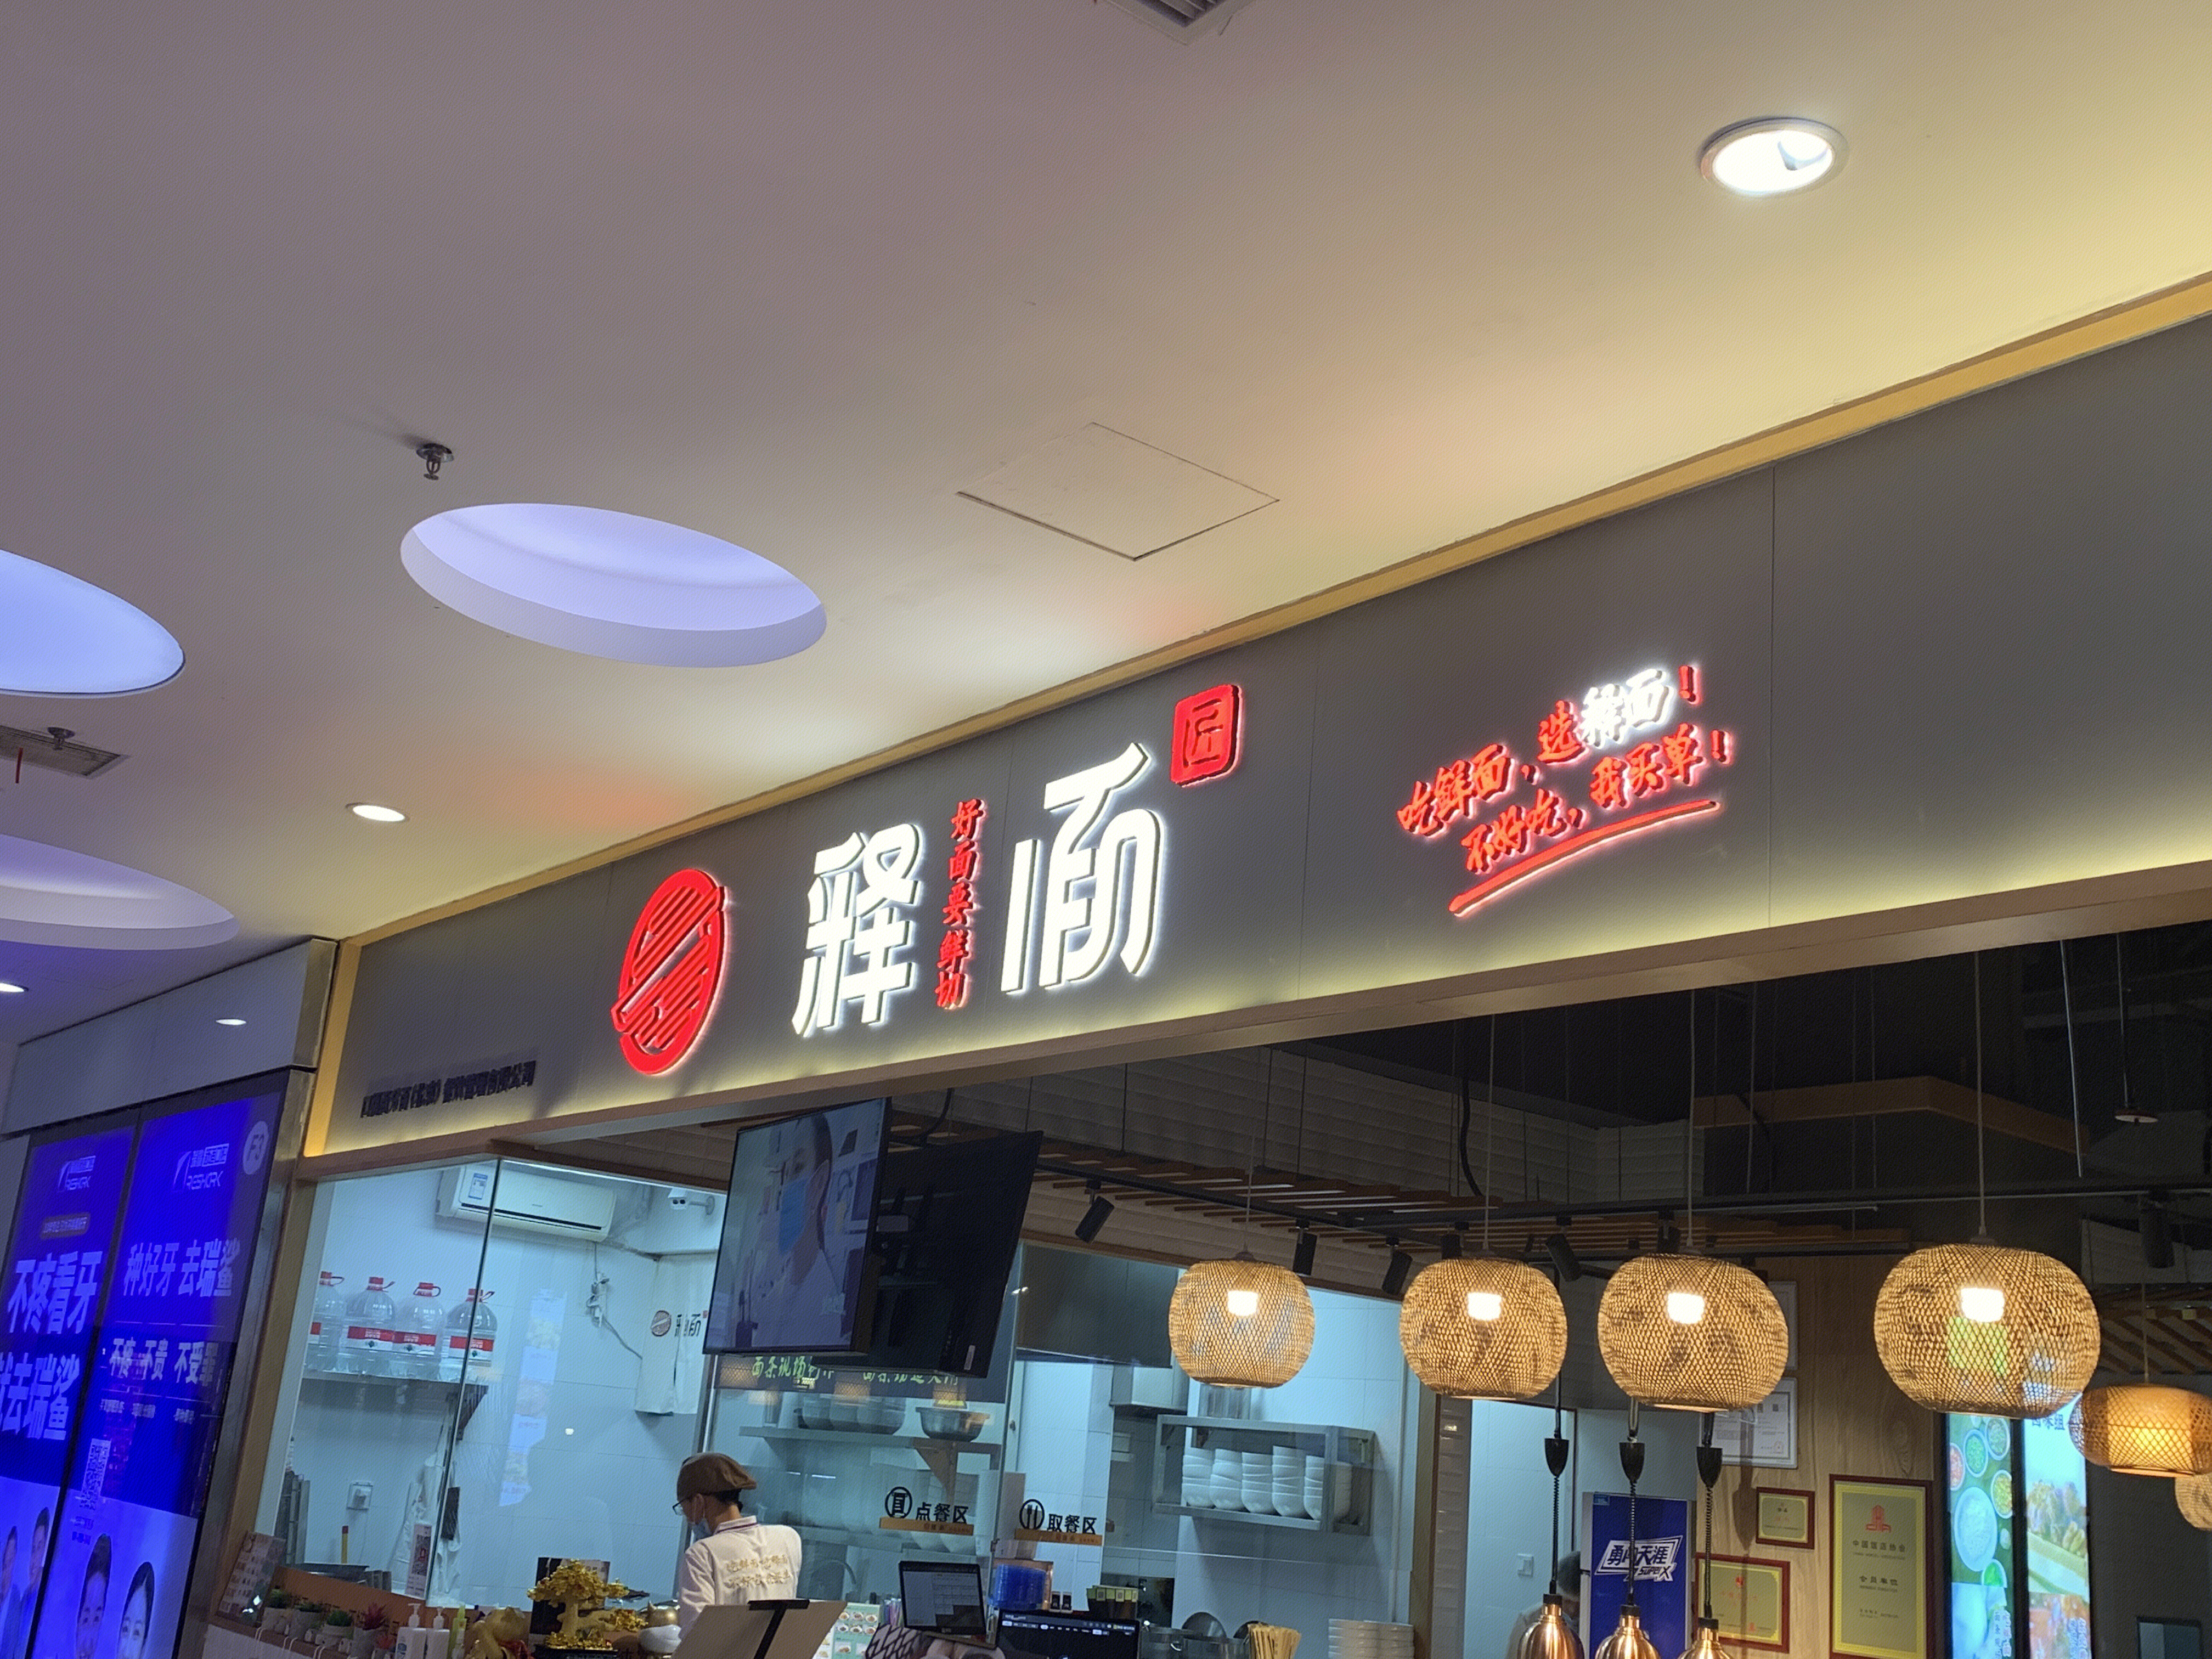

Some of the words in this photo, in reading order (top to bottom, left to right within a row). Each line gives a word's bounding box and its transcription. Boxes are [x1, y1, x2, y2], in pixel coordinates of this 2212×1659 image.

[8, 1250, 103, 1335] 不疼看牙
[123, 1242, 180, 1297] 种好牙
[178, 1238, 241, 1298] 去瑞鲨
[109, 1336, 137, 1379] 不疼
[142, 1338, 169, 1381] 不贵
[174, 1341, 219, 1387] 不受罪
[916, 1502, 969, 1524] 点餐区
[1048, 1513, 1097, 1535] 取餐区
